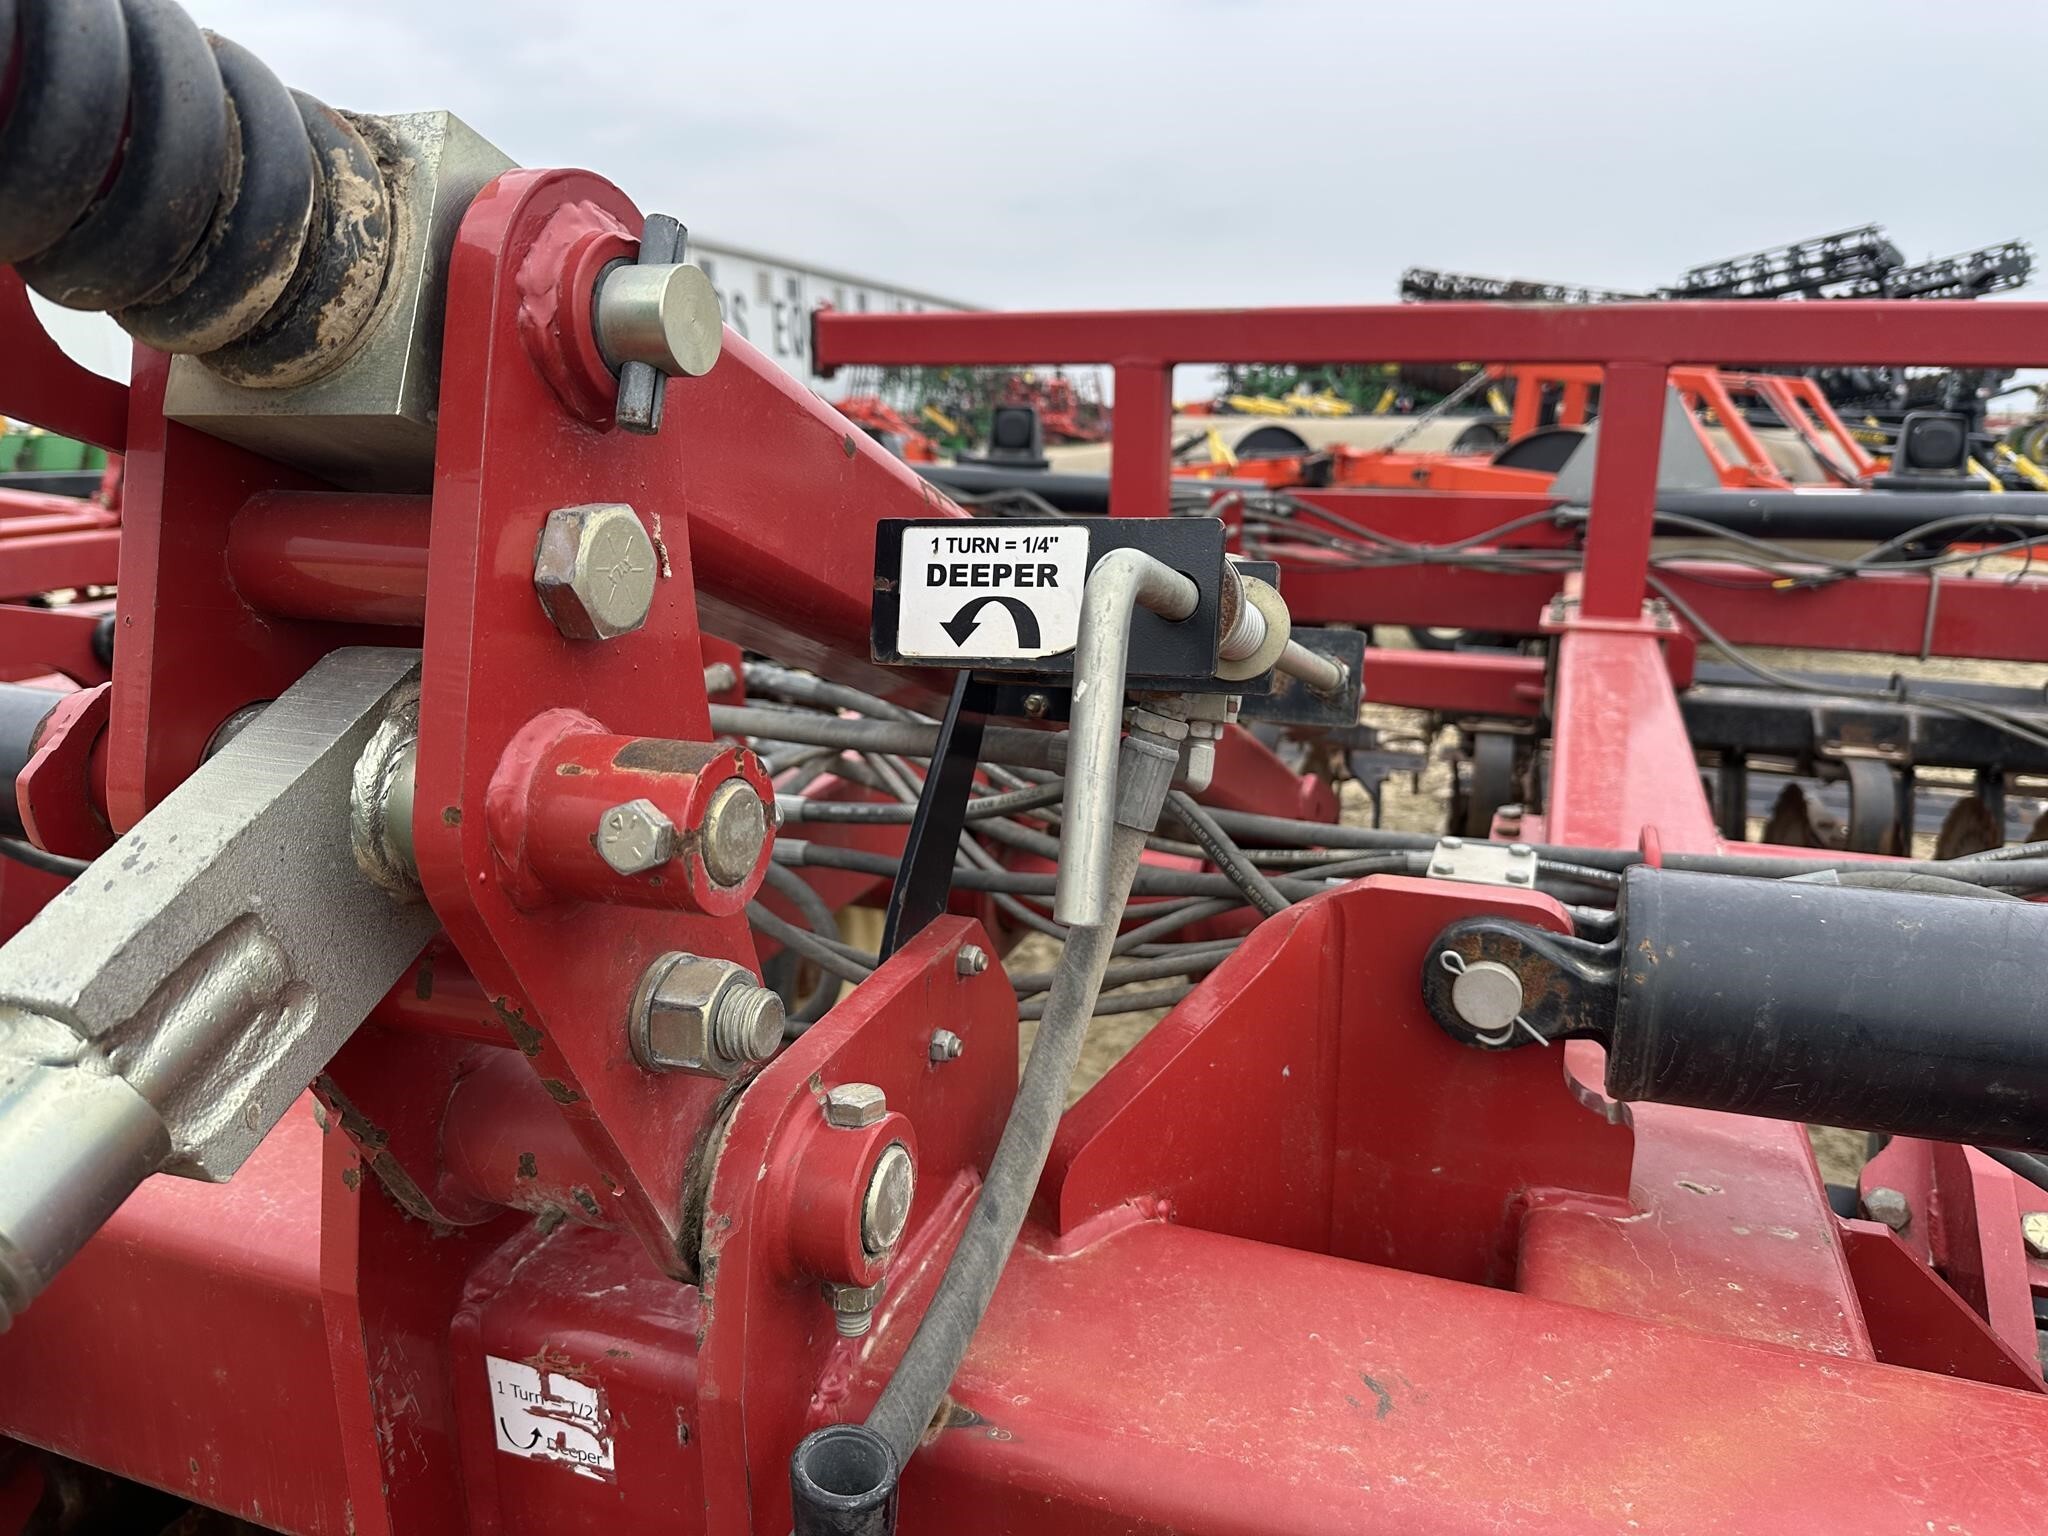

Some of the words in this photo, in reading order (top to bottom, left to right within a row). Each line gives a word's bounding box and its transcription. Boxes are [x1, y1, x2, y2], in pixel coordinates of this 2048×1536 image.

[931, 537, 939, 554] 1
[946, 537, 999, 553] TURN
[1005, 540, 1017, 550] =
[1022, 536, 1059, 553] 1/4"
[926, 563, 1059, 588] DEEPER
[497, 1380, 505, 1395] 1
[509, 1382, 544, 1405] Turn
